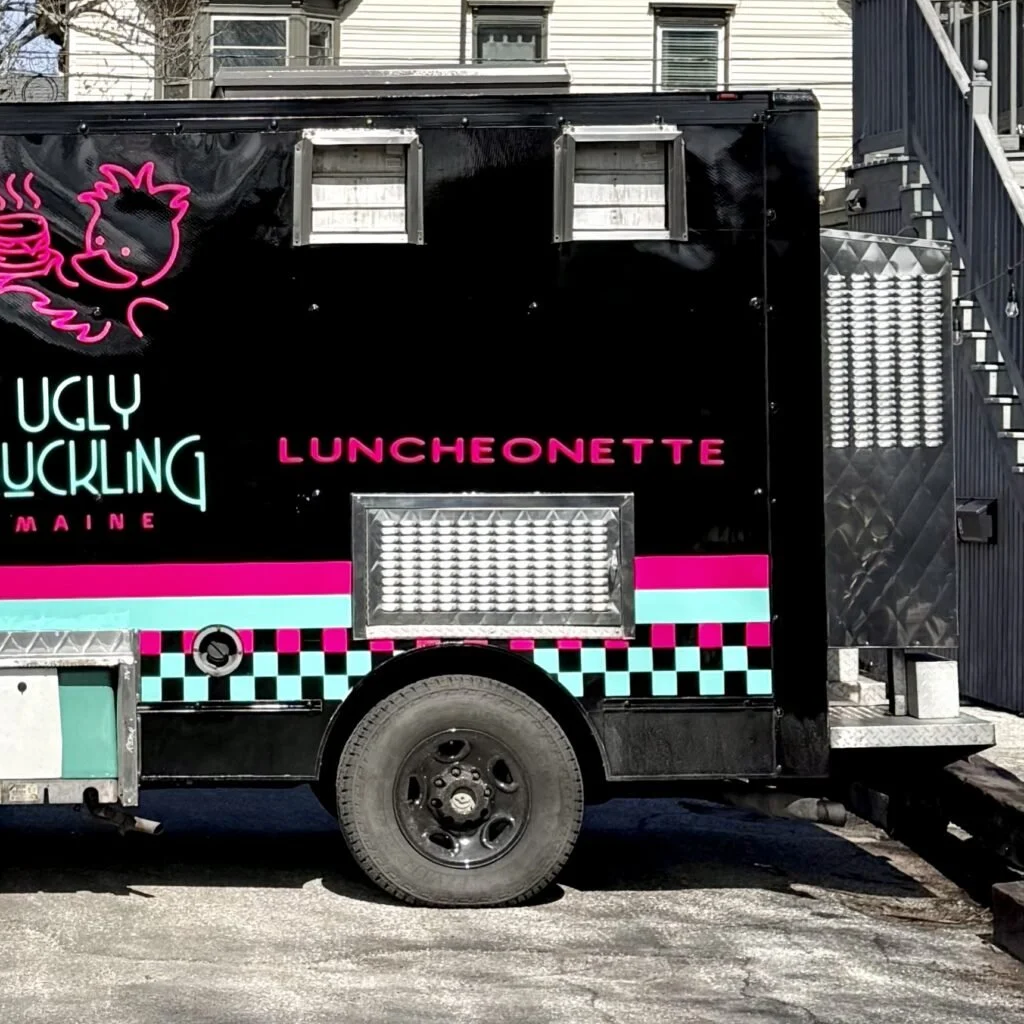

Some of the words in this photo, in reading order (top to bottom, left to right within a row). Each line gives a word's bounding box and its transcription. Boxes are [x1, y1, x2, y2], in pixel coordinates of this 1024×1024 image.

[16, 373, 142, 433] UGLY
[277, 436, 723, 467] LUNCHEONETTE
[14, 512, 155, 532] MAINE
